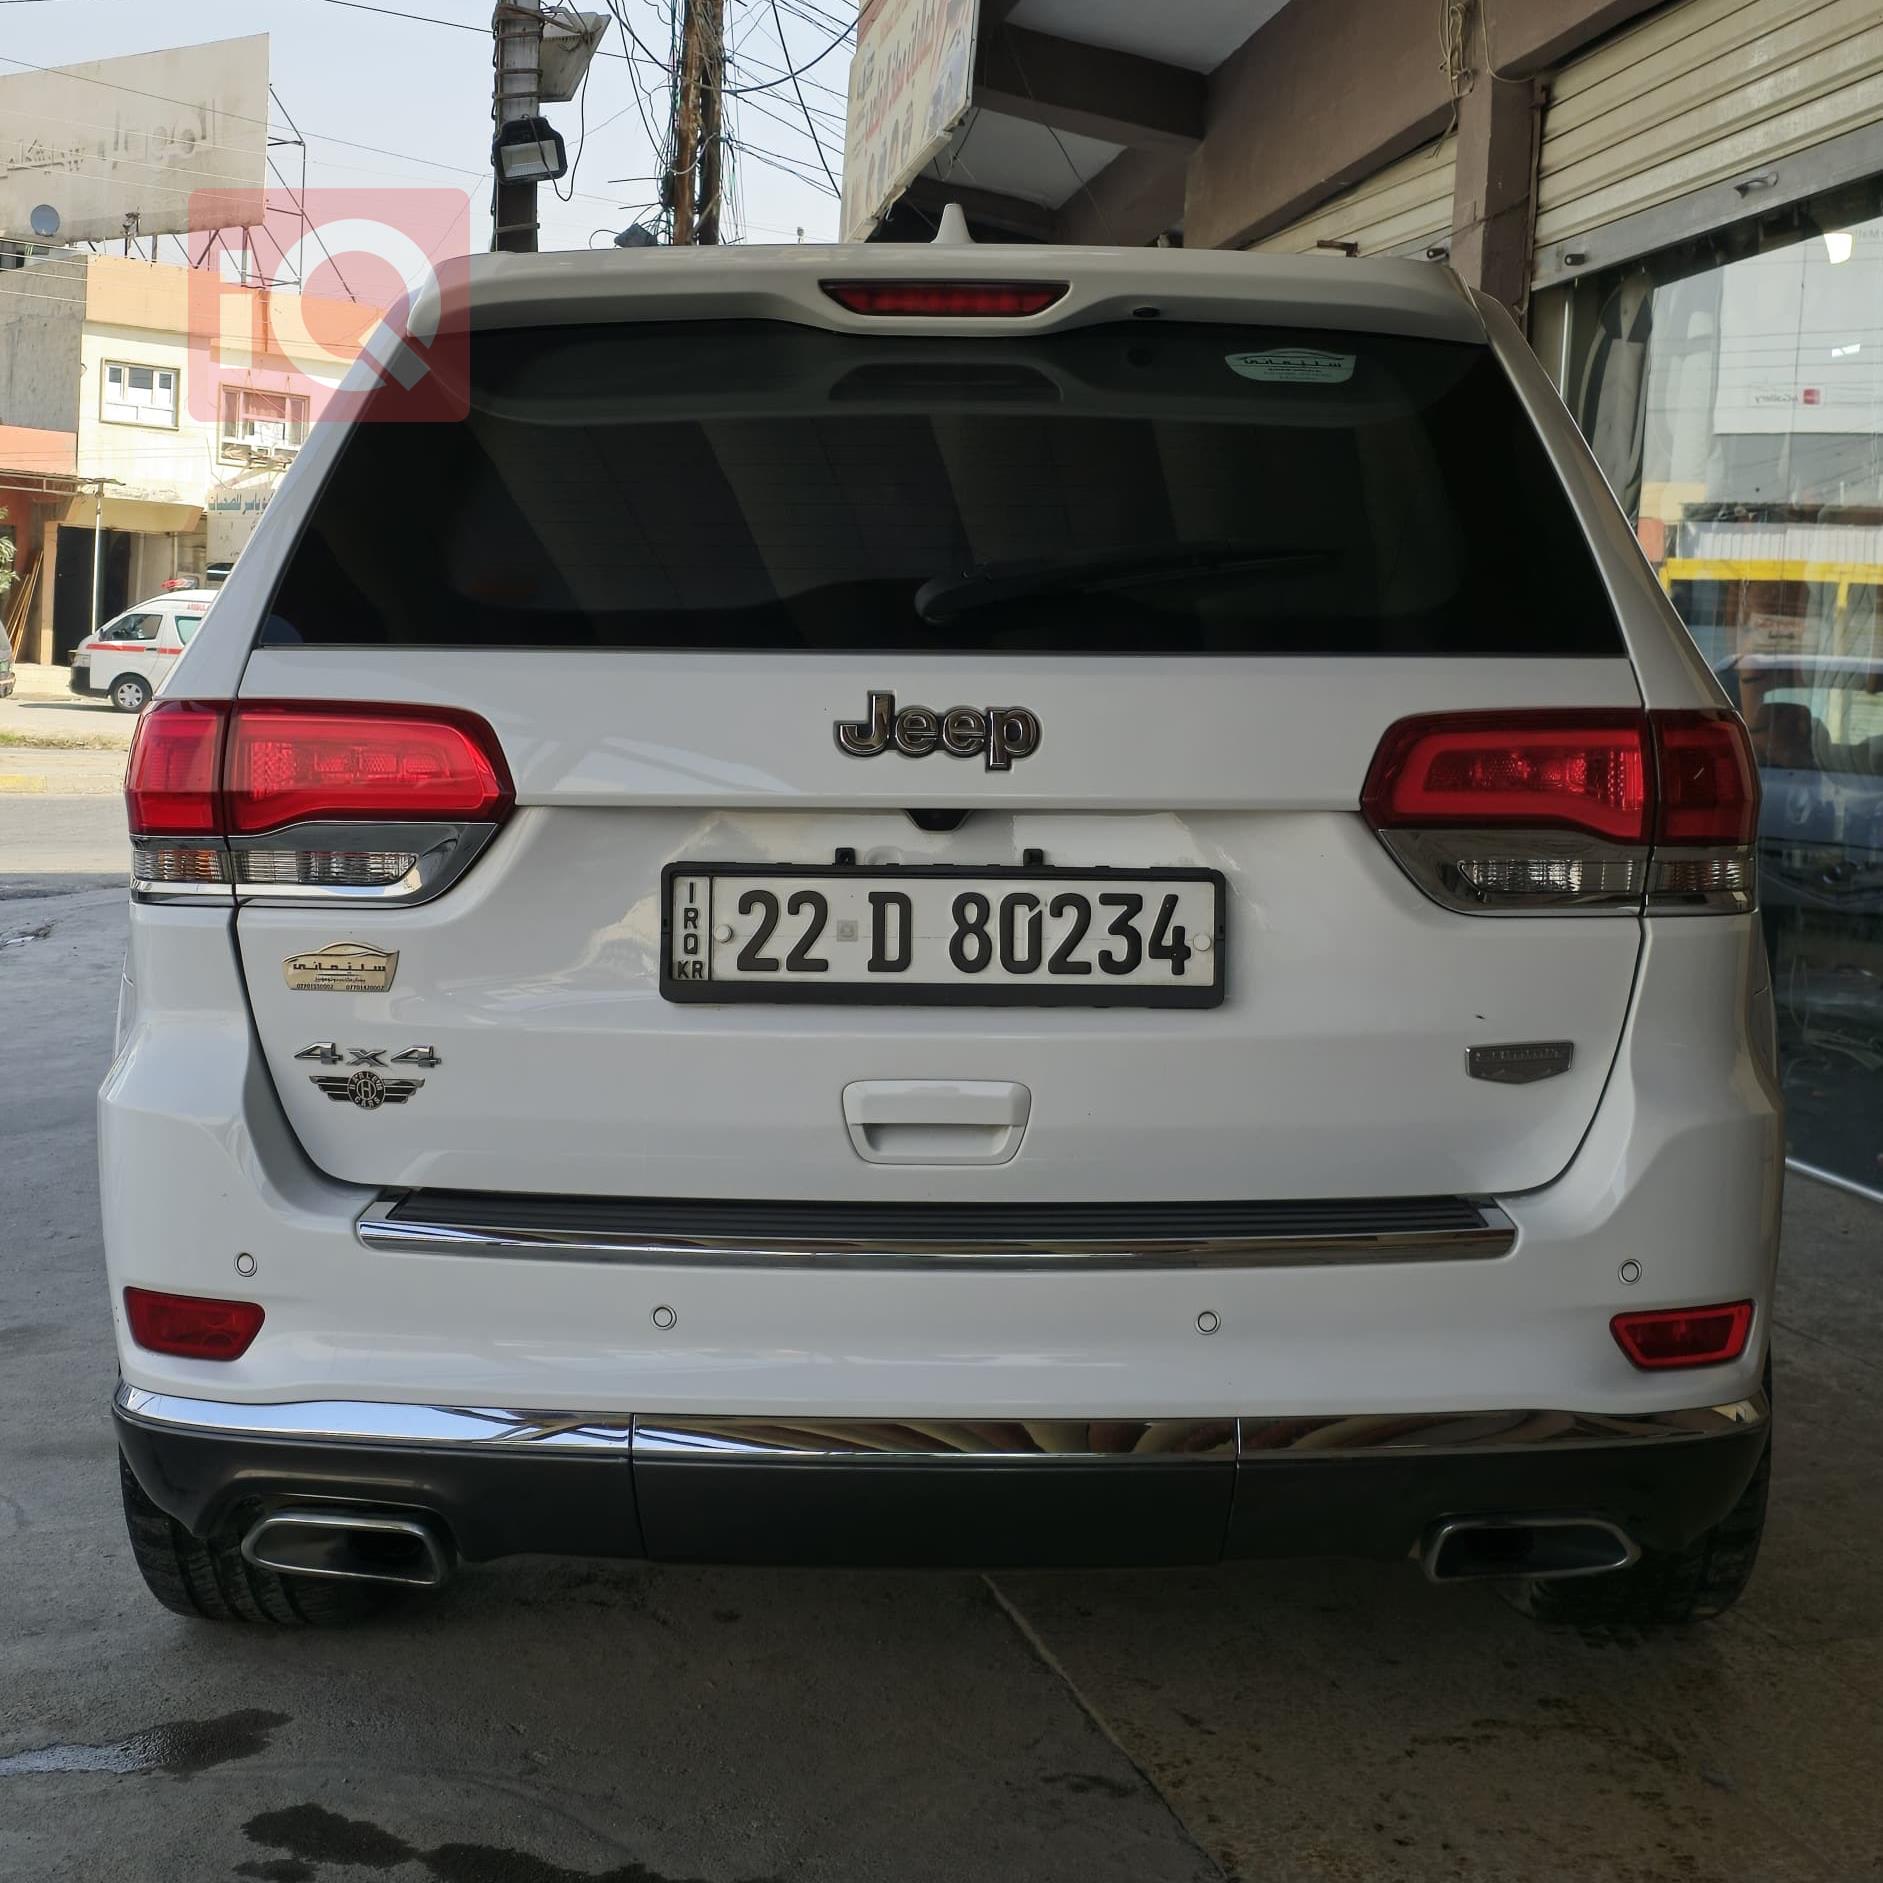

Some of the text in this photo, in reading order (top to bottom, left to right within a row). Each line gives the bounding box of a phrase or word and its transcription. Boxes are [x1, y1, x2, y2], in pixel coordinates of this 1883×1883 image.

[834, 690, 1042, 773] Jeep
[683, 882, 699, 955] IRQ
[736, 889, 1191, 976] 22 D 80234
[677, 960, 703, 979] KR
[354, 1096, 381, 1109] CARS
